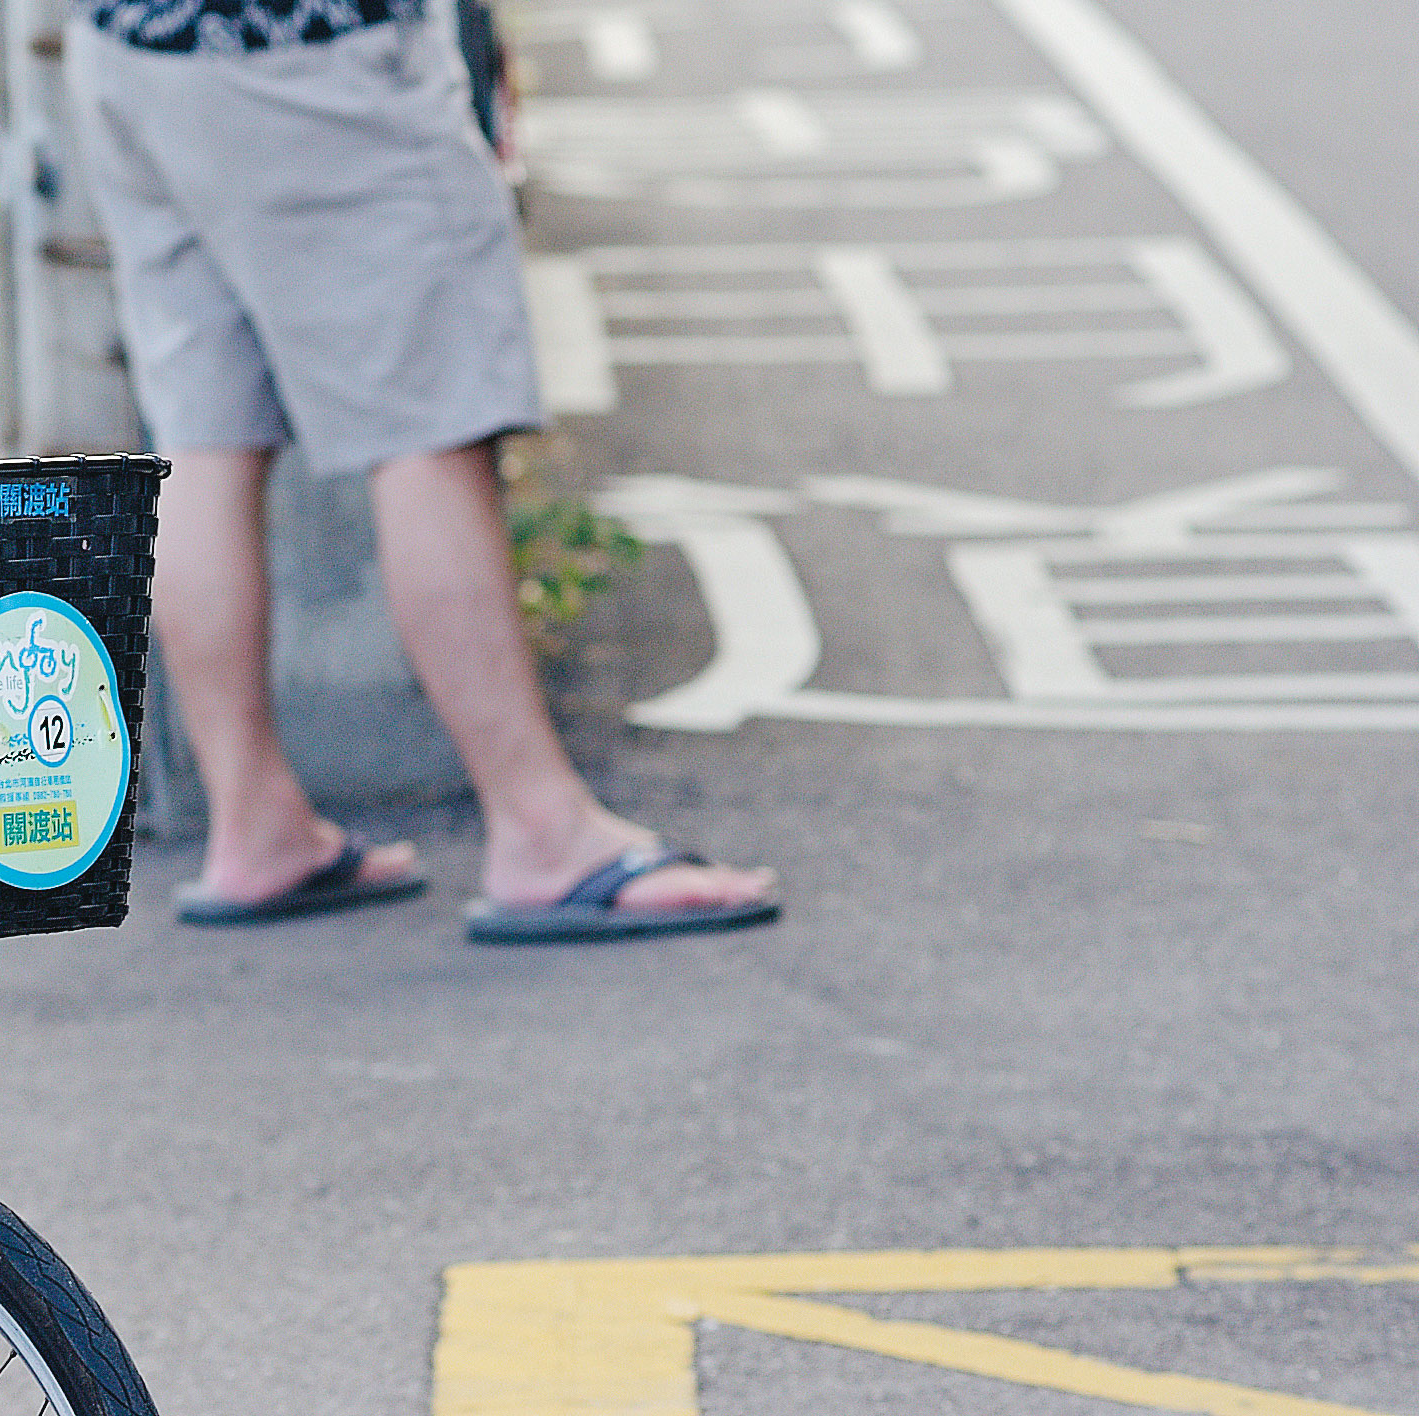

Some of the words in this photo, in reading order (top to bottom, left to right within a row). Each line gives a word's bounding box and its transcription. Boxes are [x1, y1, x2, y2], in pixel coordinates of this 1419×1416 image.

[0, 482, 70, 517] 關渡站
[6, 675, 23, 691] life
[39, 715, 65, 750] 12
[3, 807, 72, 846] 關渡站
